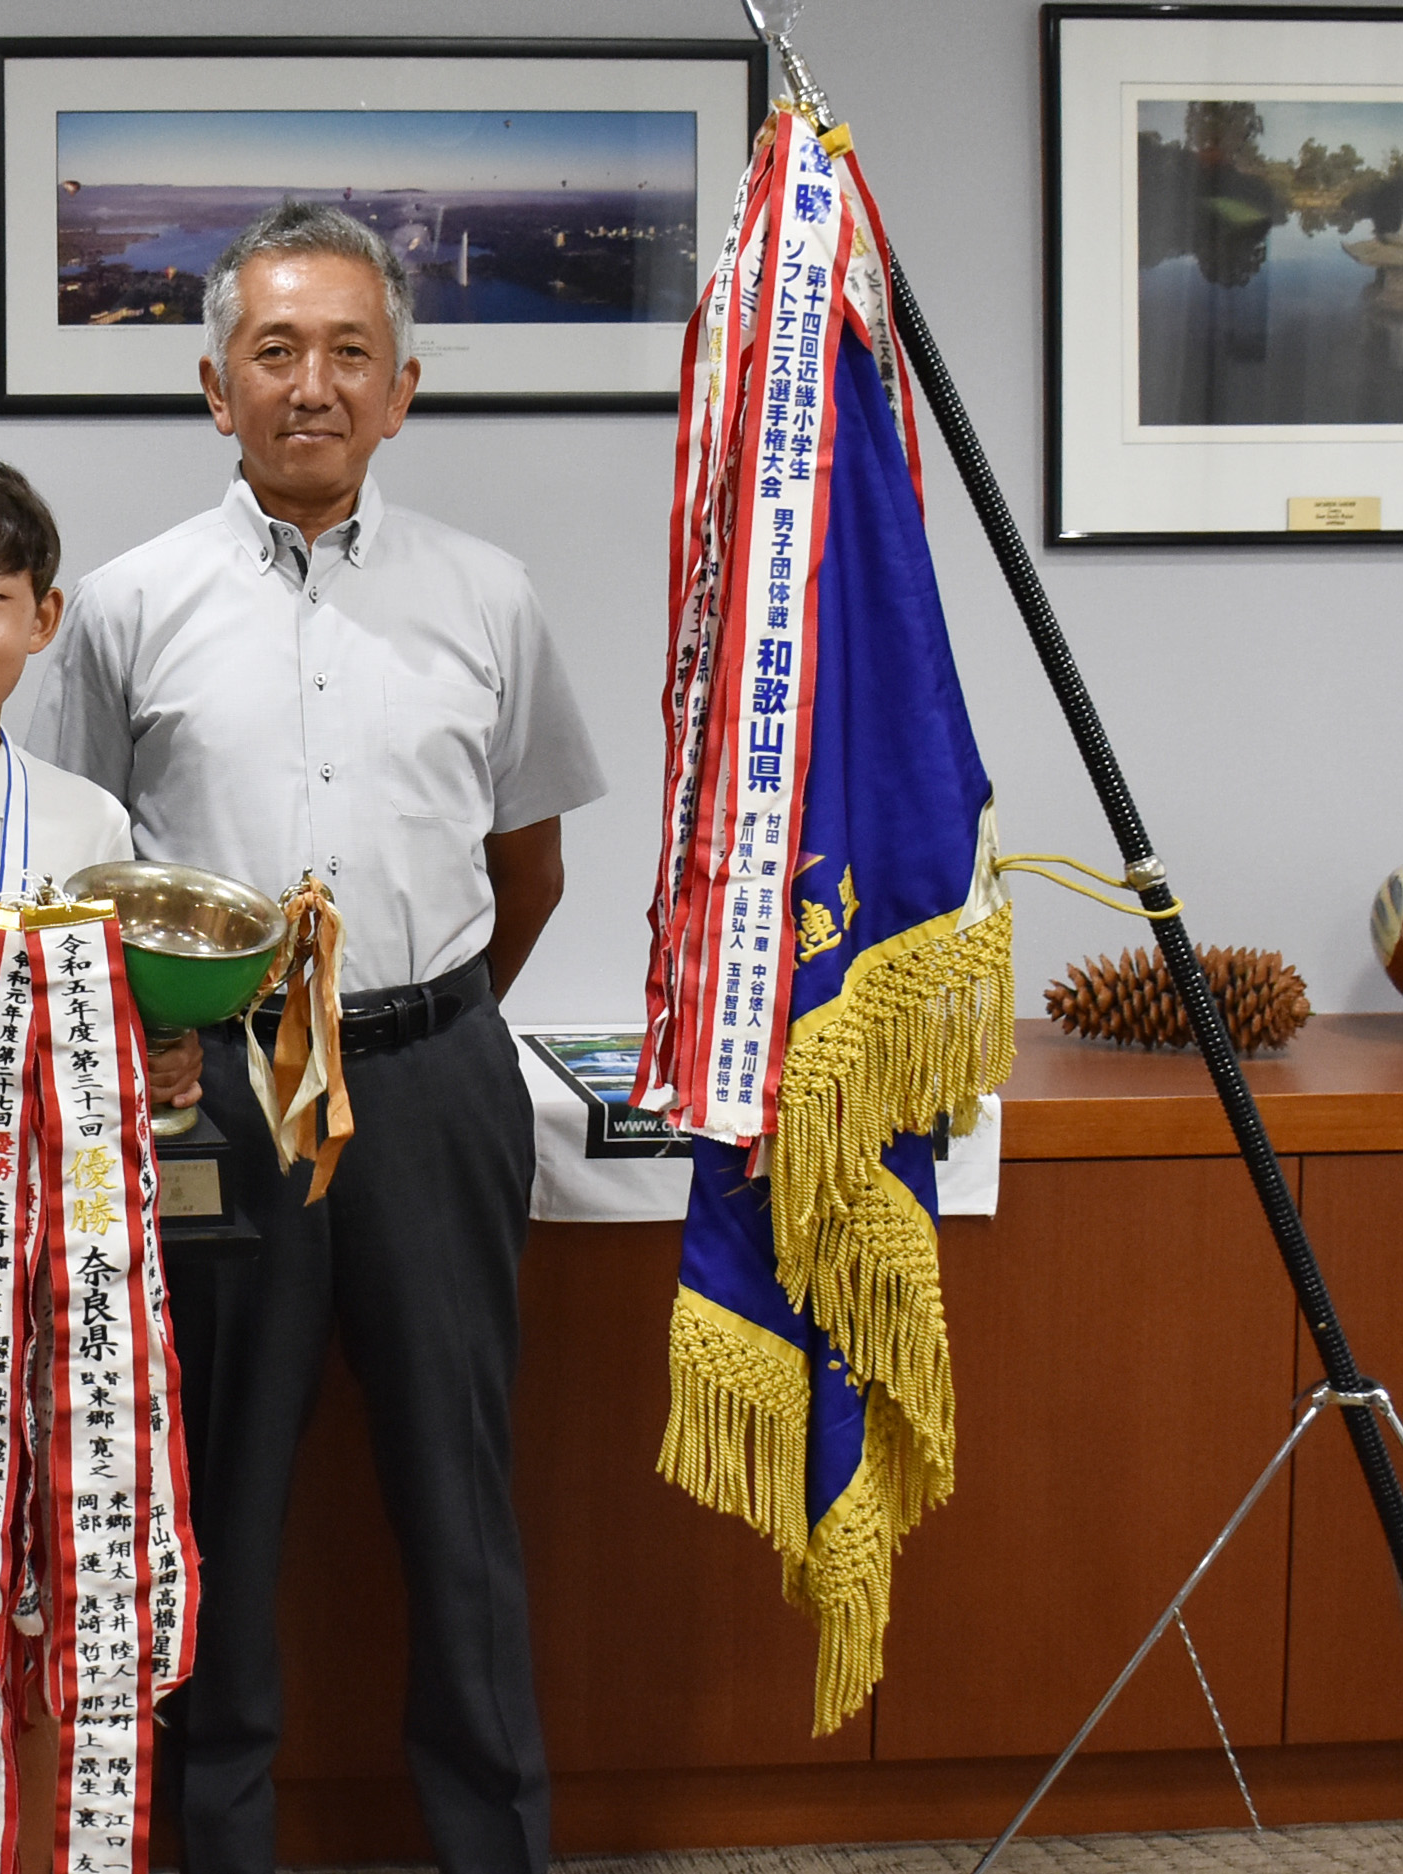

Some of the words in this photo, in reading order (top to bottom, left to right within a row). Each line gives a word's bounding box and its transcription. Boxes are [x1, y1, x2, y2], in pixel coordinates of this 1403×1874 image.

[760, 239, 806, 500] ソフトテニス選手権大会
[788, 264, 827, 481] 第十四回近畿小学生
[767, 507, 794, 630] 男子団体戦
[747, 637, 793, 794] 和歌山県
[56, 933, 105, 1138] 令和五年度第三十一回
[67, 1144, 124, 1237] 優勝
[76, 1245, 123, 1363] 奈良県
[80, 1370, 122, 1386] 監督
